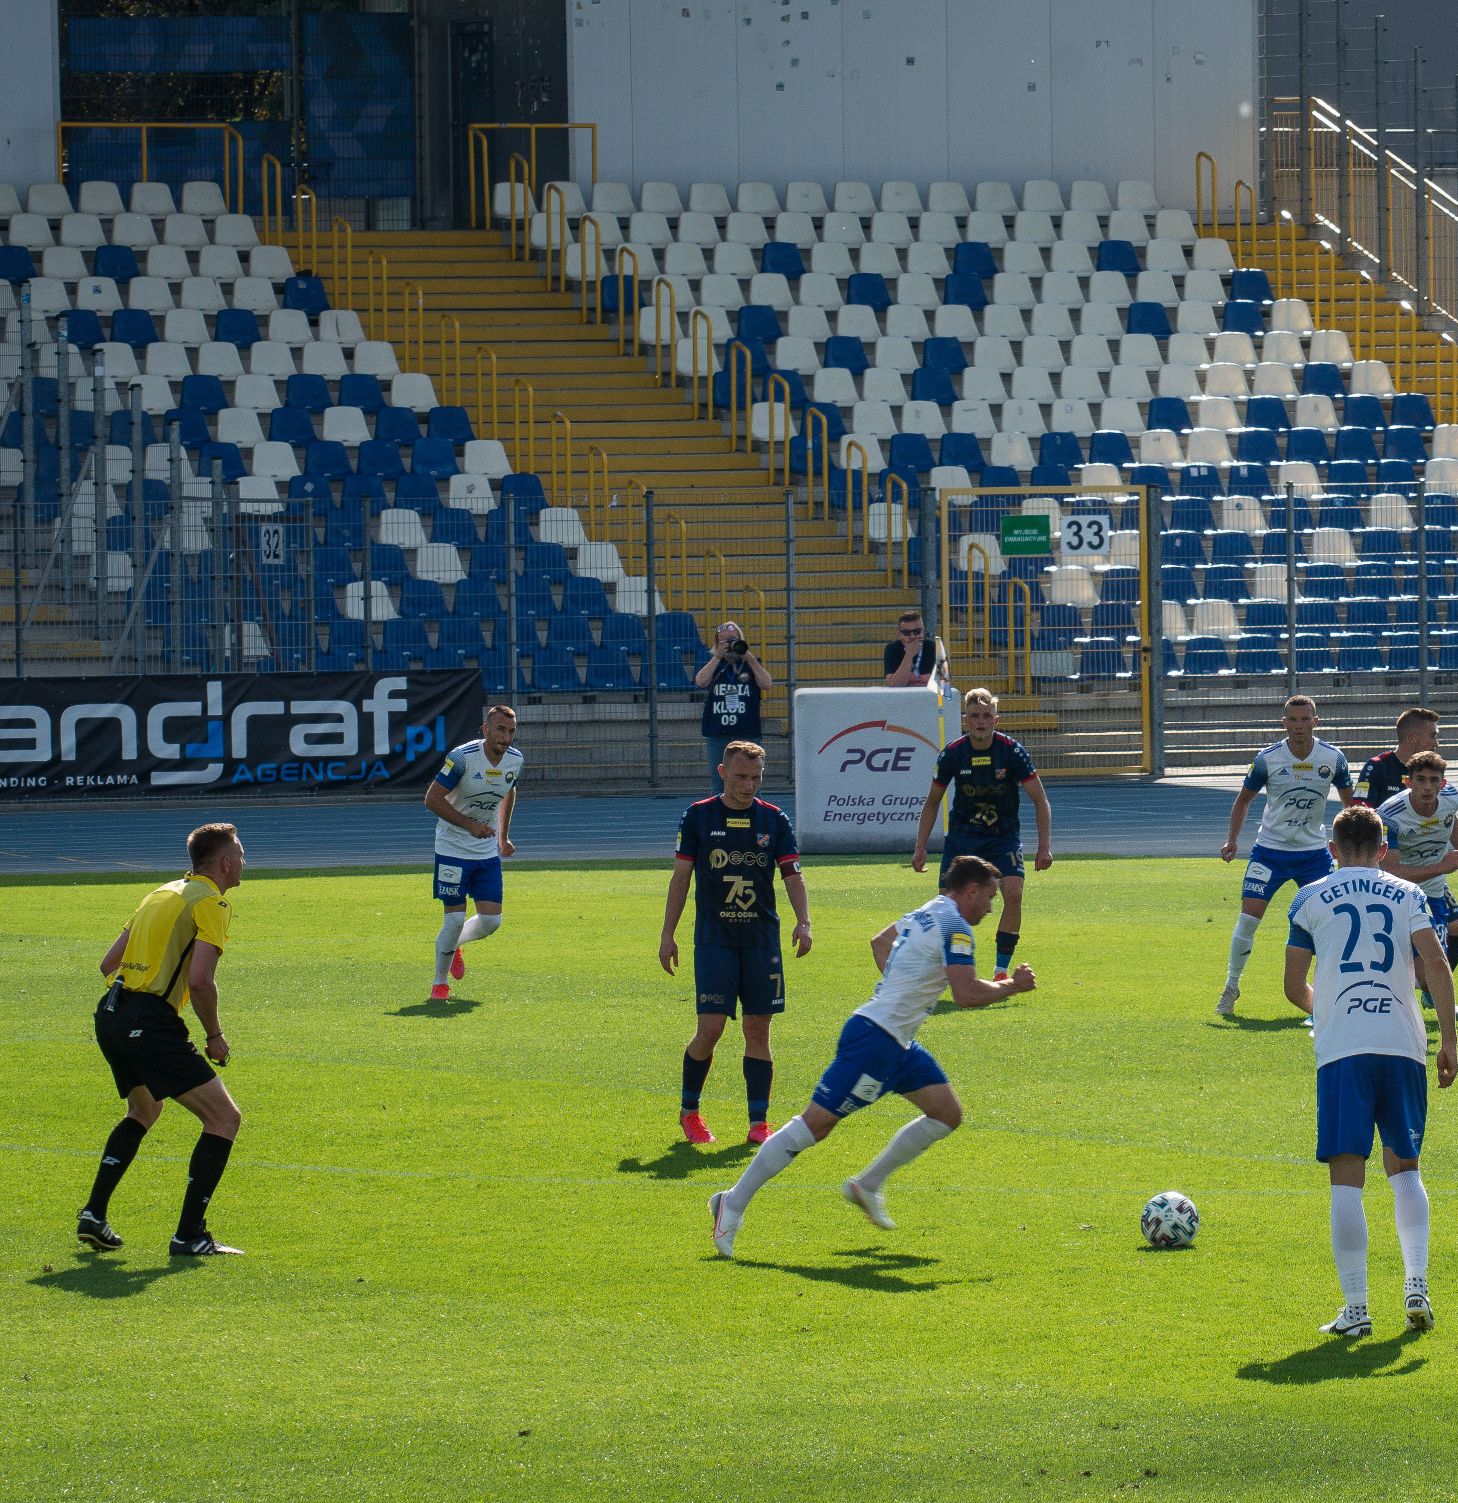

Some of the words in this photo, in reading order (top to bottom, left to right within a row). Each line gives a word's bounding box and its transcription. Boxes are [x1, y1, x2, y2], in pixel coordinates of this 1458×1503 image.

[1066, 520, 1105, 551] 33
[263, 529, 280, 560] 32
[721, 715, 737, 726] 09
[840, 747, 916, 773] PGE
[66, 775, 138, 786] REKLAMA
[231, 760, 391, 784] AGENCJA
[469, 800, 498, 811] PGE
[827, 795, 875, 807] Polska
[881, 794, 927, 809] Grupa
[1284, 798, 1316, 810] PGE
[823, 810, 921, 825] Energetyczna
[728, 850, 769, 867] eco
[722, 875, 757, 911] 75
[1319, 878, 1405, 905] GETINGER
[1332, 902, 1395, 974] 23
[768, 974, 782, 998] 7
[1347, 997, 1393, 1014] PGE
[1407, 1299, 1424, 1309] NIKE
